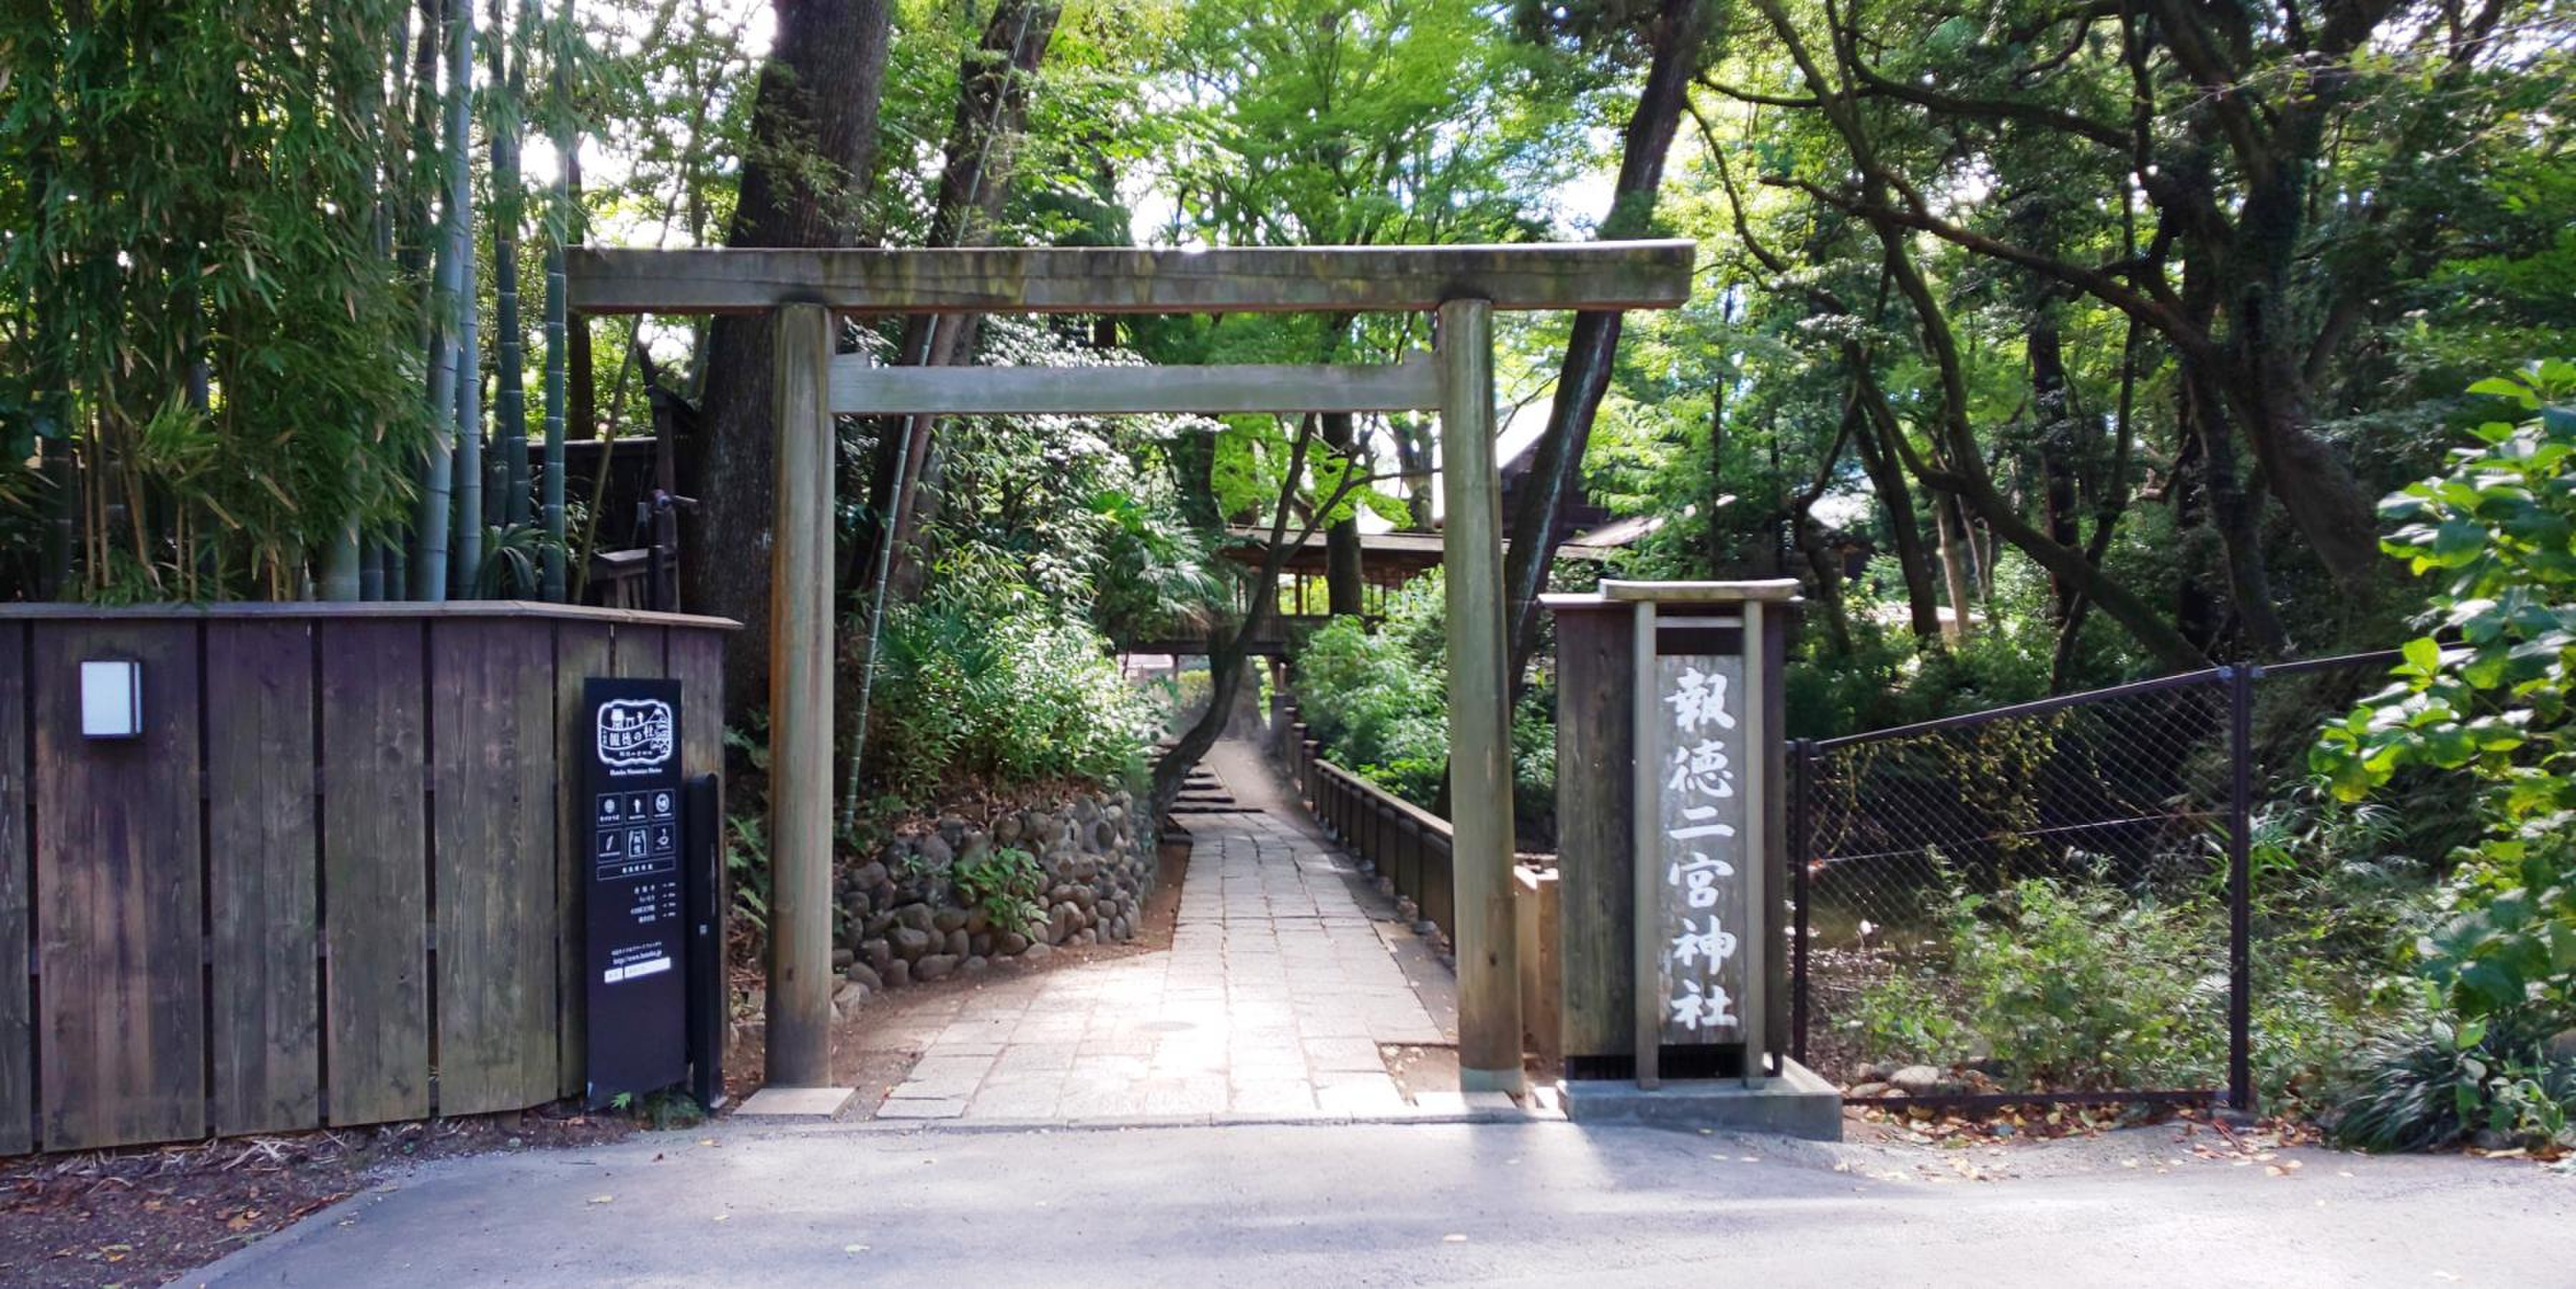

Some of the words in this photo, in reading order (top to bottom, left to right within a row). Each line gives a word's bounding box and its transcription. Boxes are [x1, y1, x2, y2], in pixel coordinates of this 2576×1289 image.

[1665, 667, 1738, 1030] 報徳二宮神社
